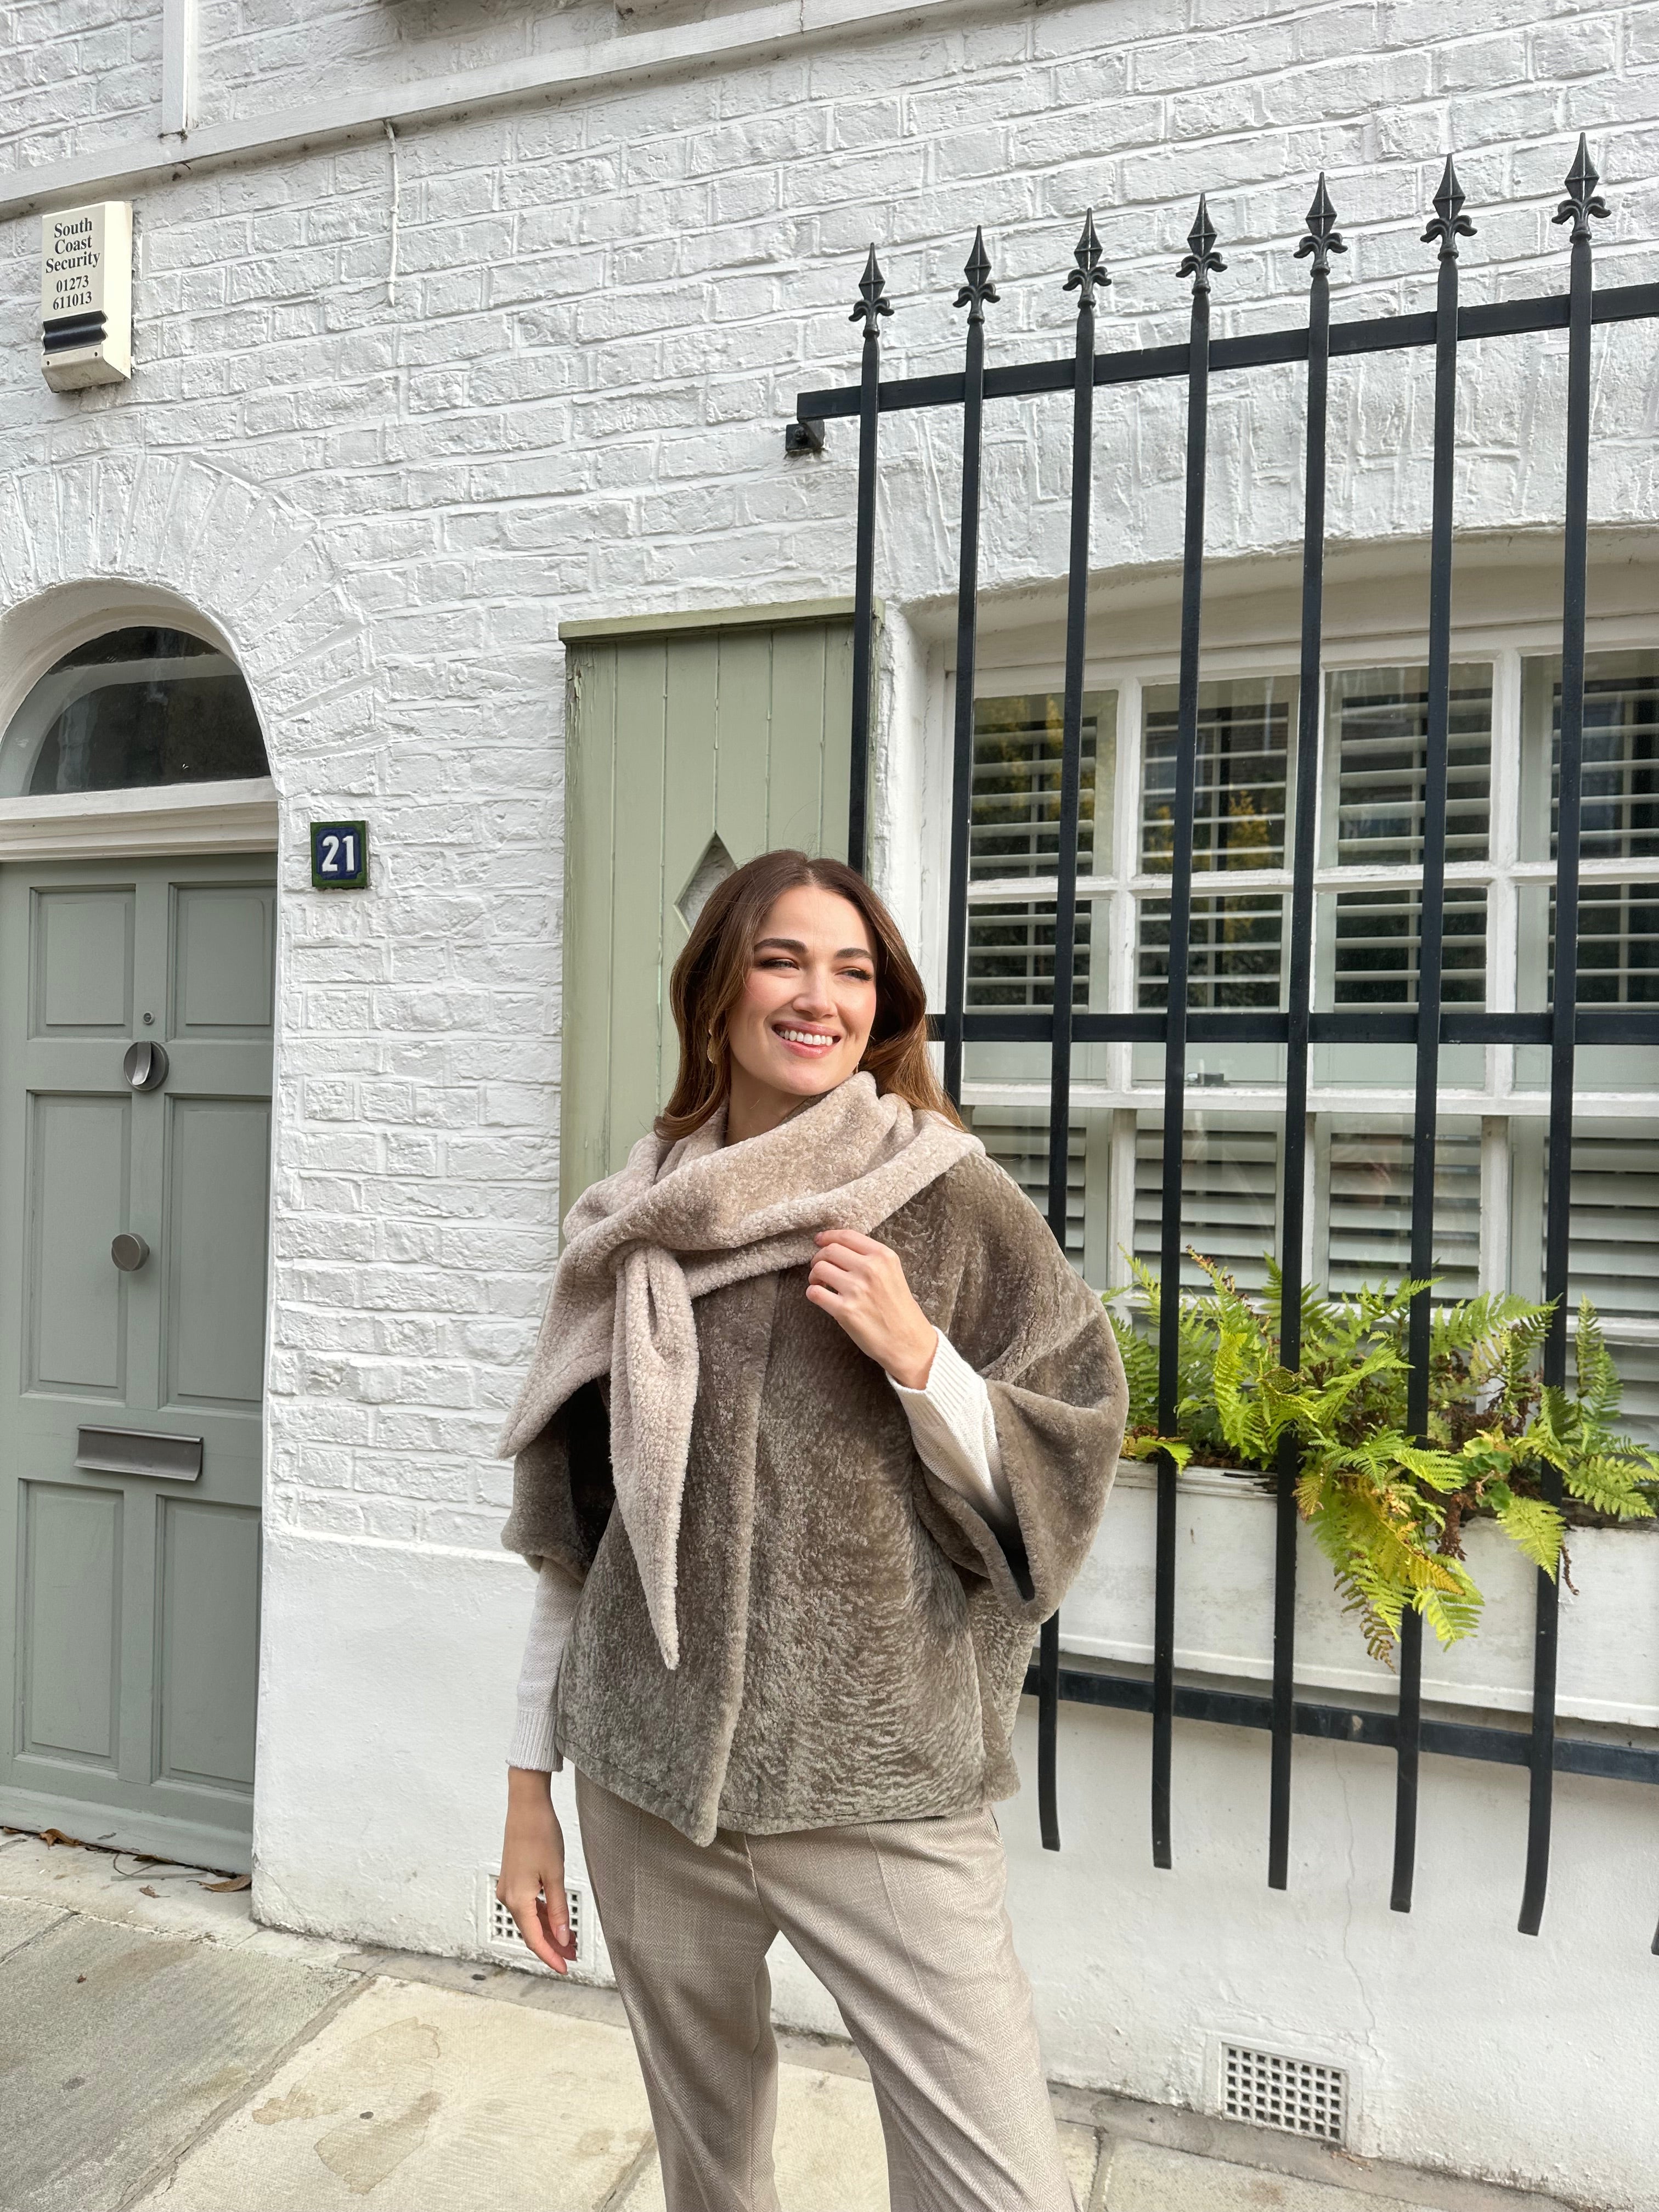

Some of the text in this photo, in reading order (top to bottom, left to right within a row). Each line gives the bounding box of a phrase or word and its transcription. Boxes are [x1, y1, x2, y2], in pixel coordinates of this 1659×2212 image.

[54, 217, 93, 238] South
[55, 235, 92, 255] Coast
[46, 251, 100, 273] Security
[56, 275, 89, 293] 01273
[53, 291, 92, 310] 611013
[322, 836, 354, 872] 21
